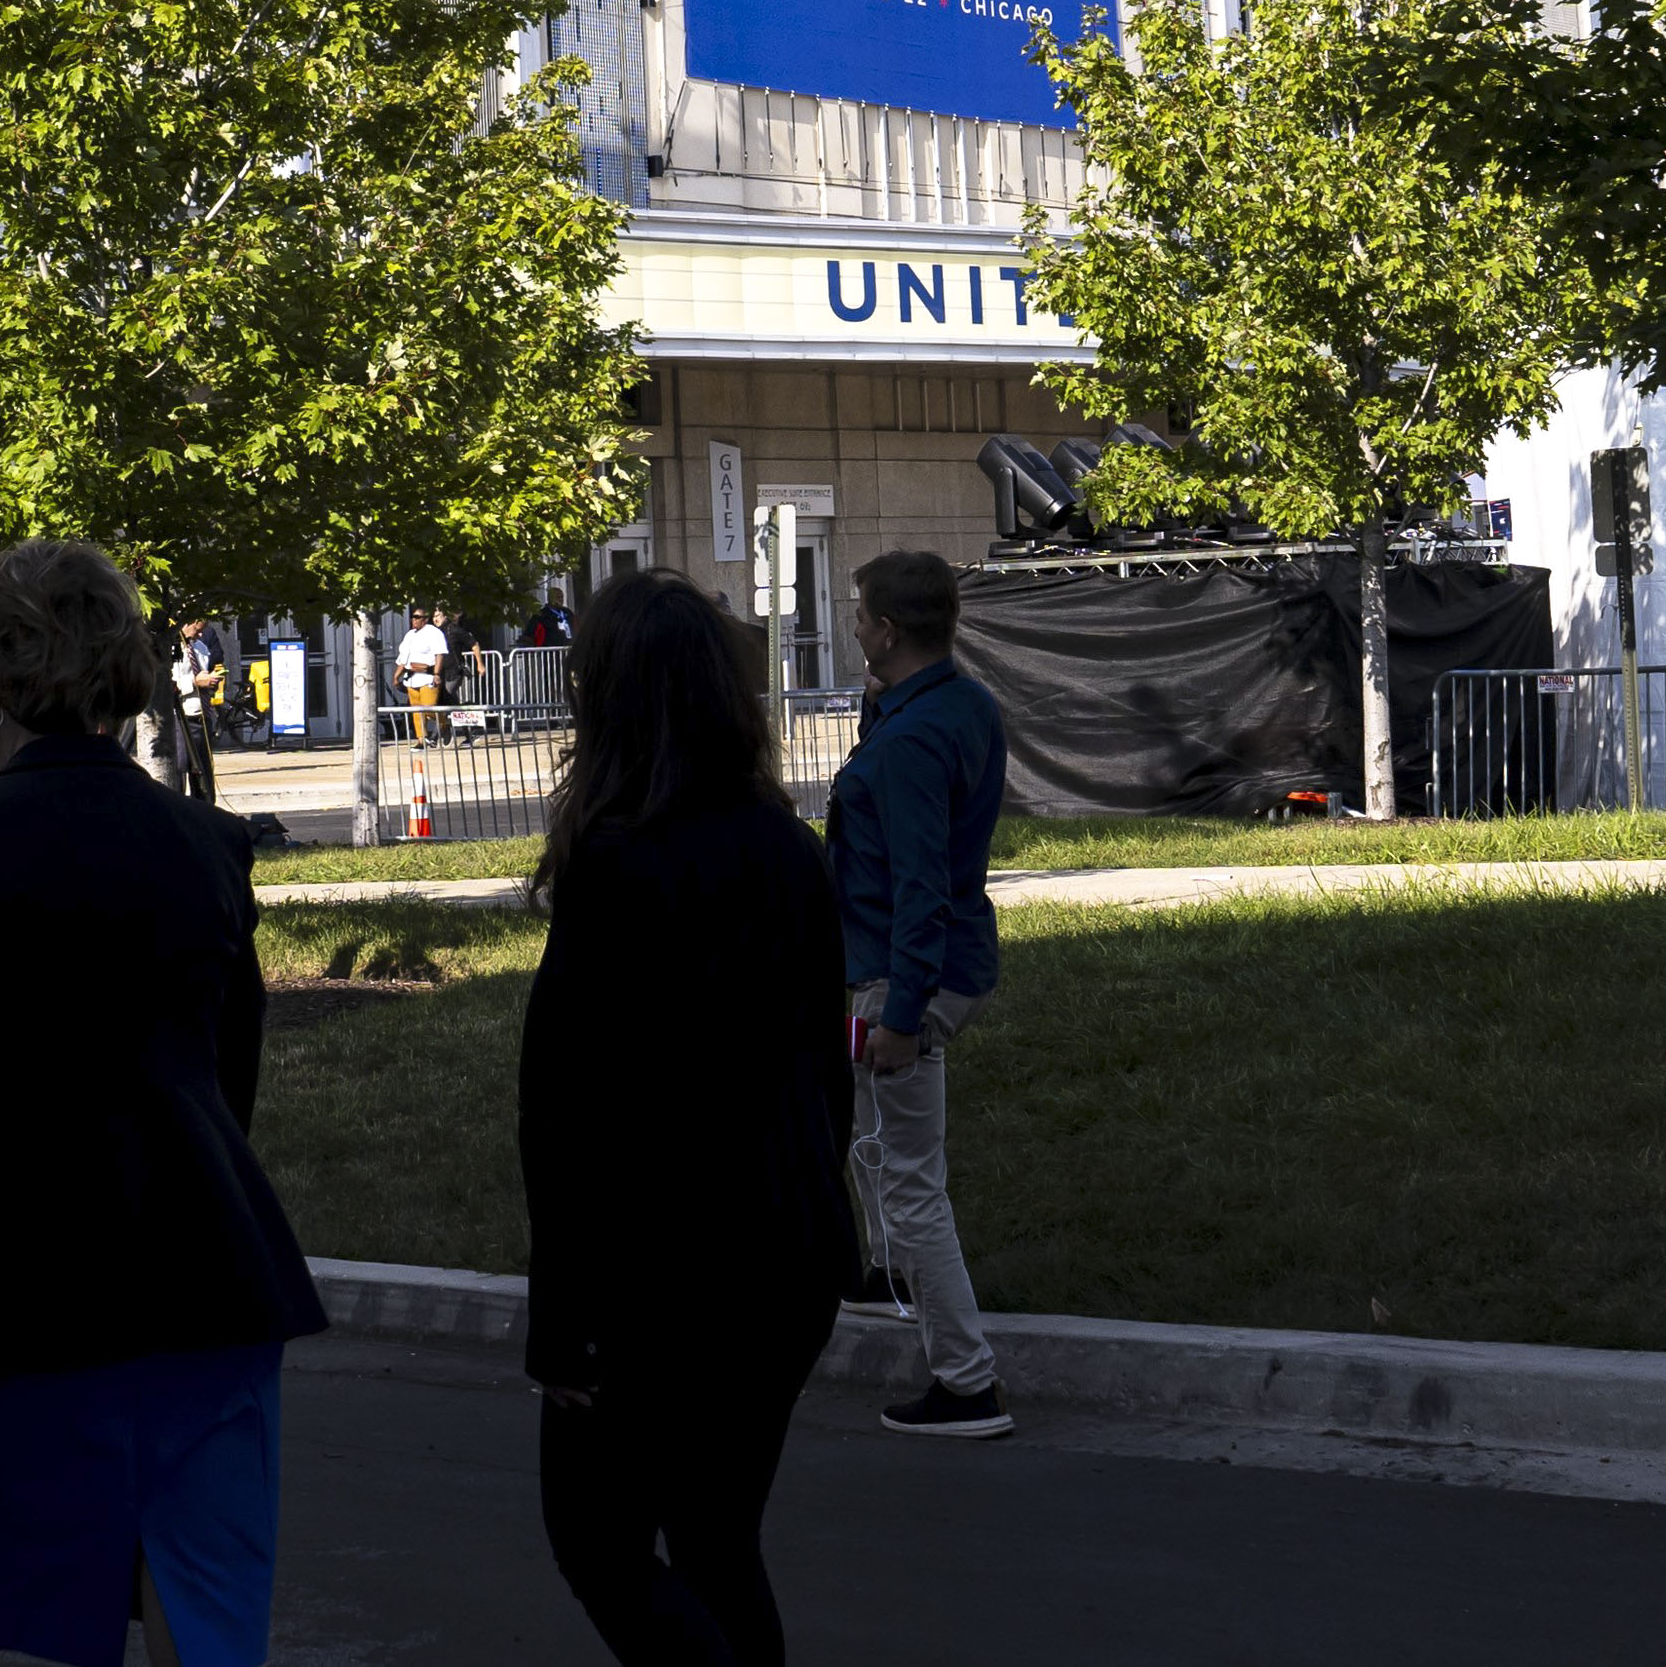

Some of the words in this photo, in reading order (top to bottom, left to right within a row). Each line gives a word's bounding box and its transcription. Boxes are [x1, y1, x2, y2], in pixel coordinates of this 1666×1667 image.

[827, 260, 1075, 327] UNIT
[719, 454, 734, 529] GATE
[724, 535, 735, 552] 7
[1539, 675, 1574, 685] NATIONAL
